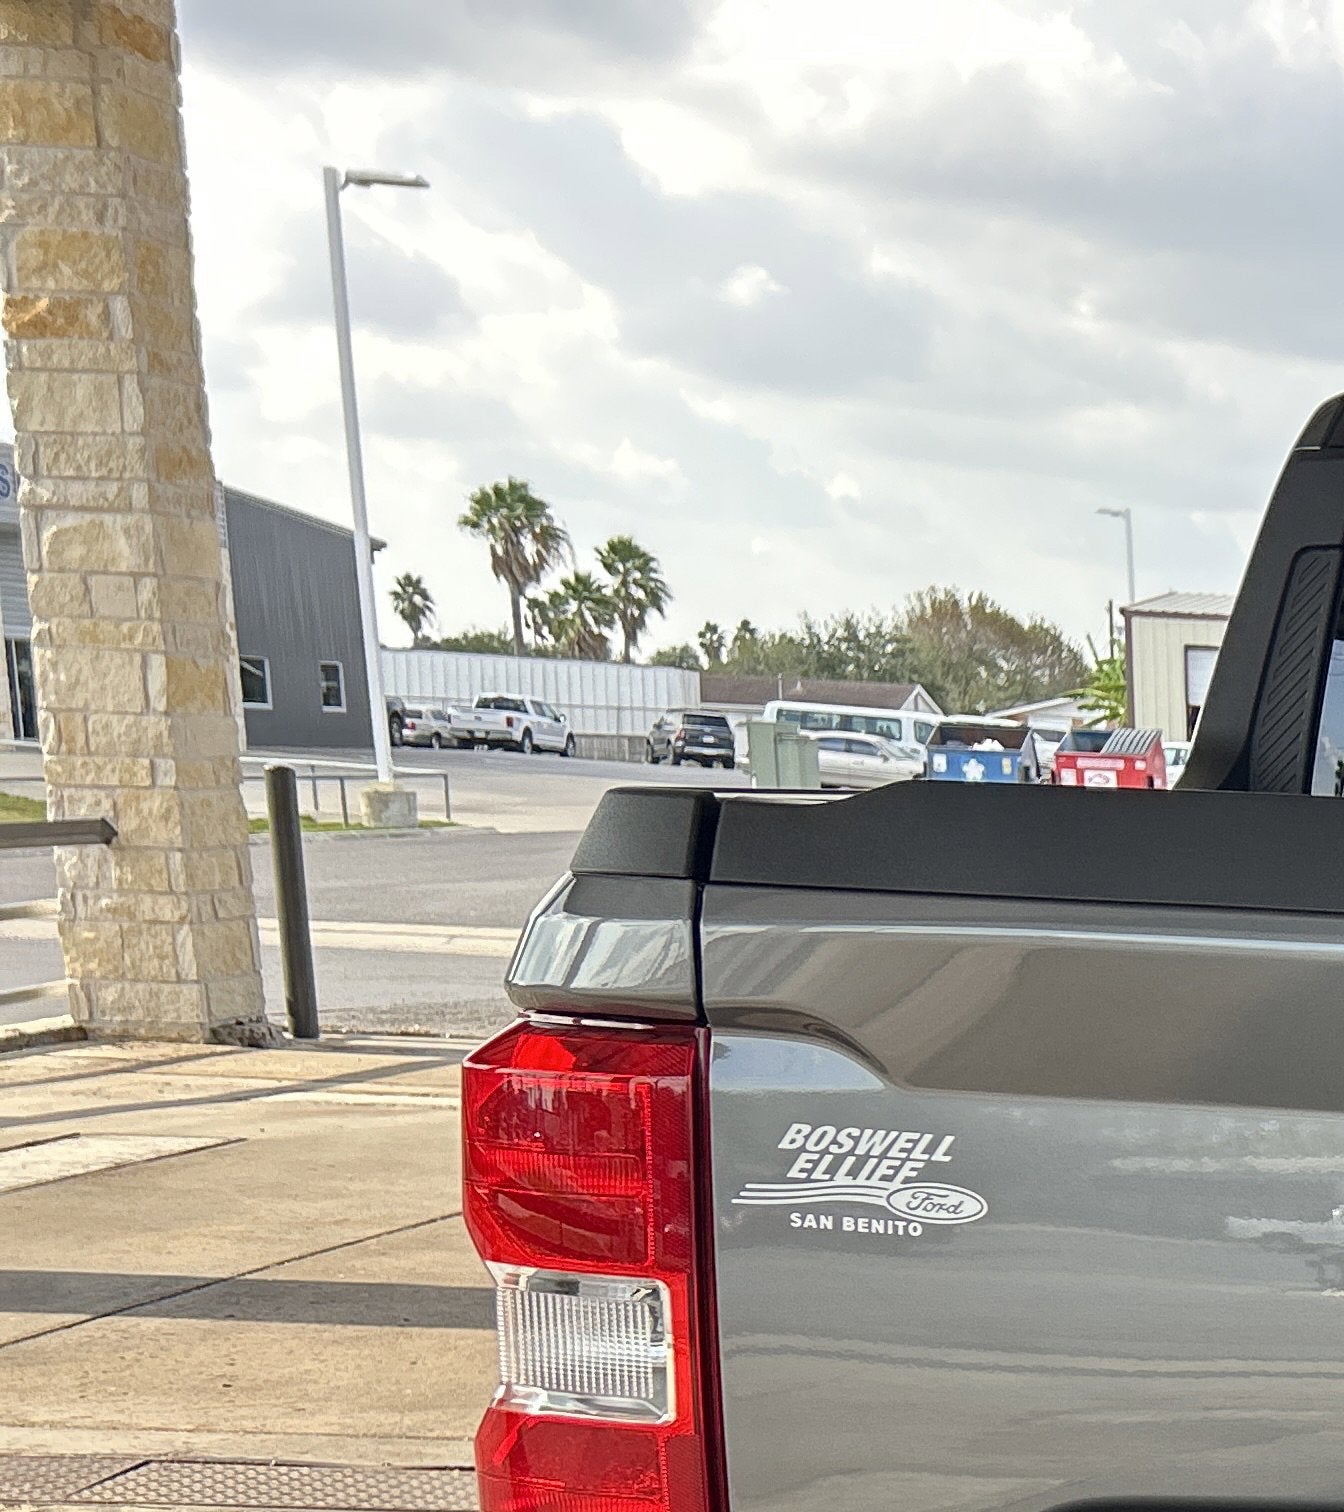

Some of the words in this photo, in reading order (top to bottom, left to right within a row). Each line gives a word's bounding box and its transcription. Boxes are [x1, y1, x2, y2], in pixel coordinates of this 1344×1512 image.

[778, 1123, 955, 1162] BOSWELL
[786, 1153, 925, 1186] ELLIFF
[906, 1190, 964, 1215] Ford
[789, 1212, 833, 1230] SAN
[842, 1217, 923, 1237] BENITO
